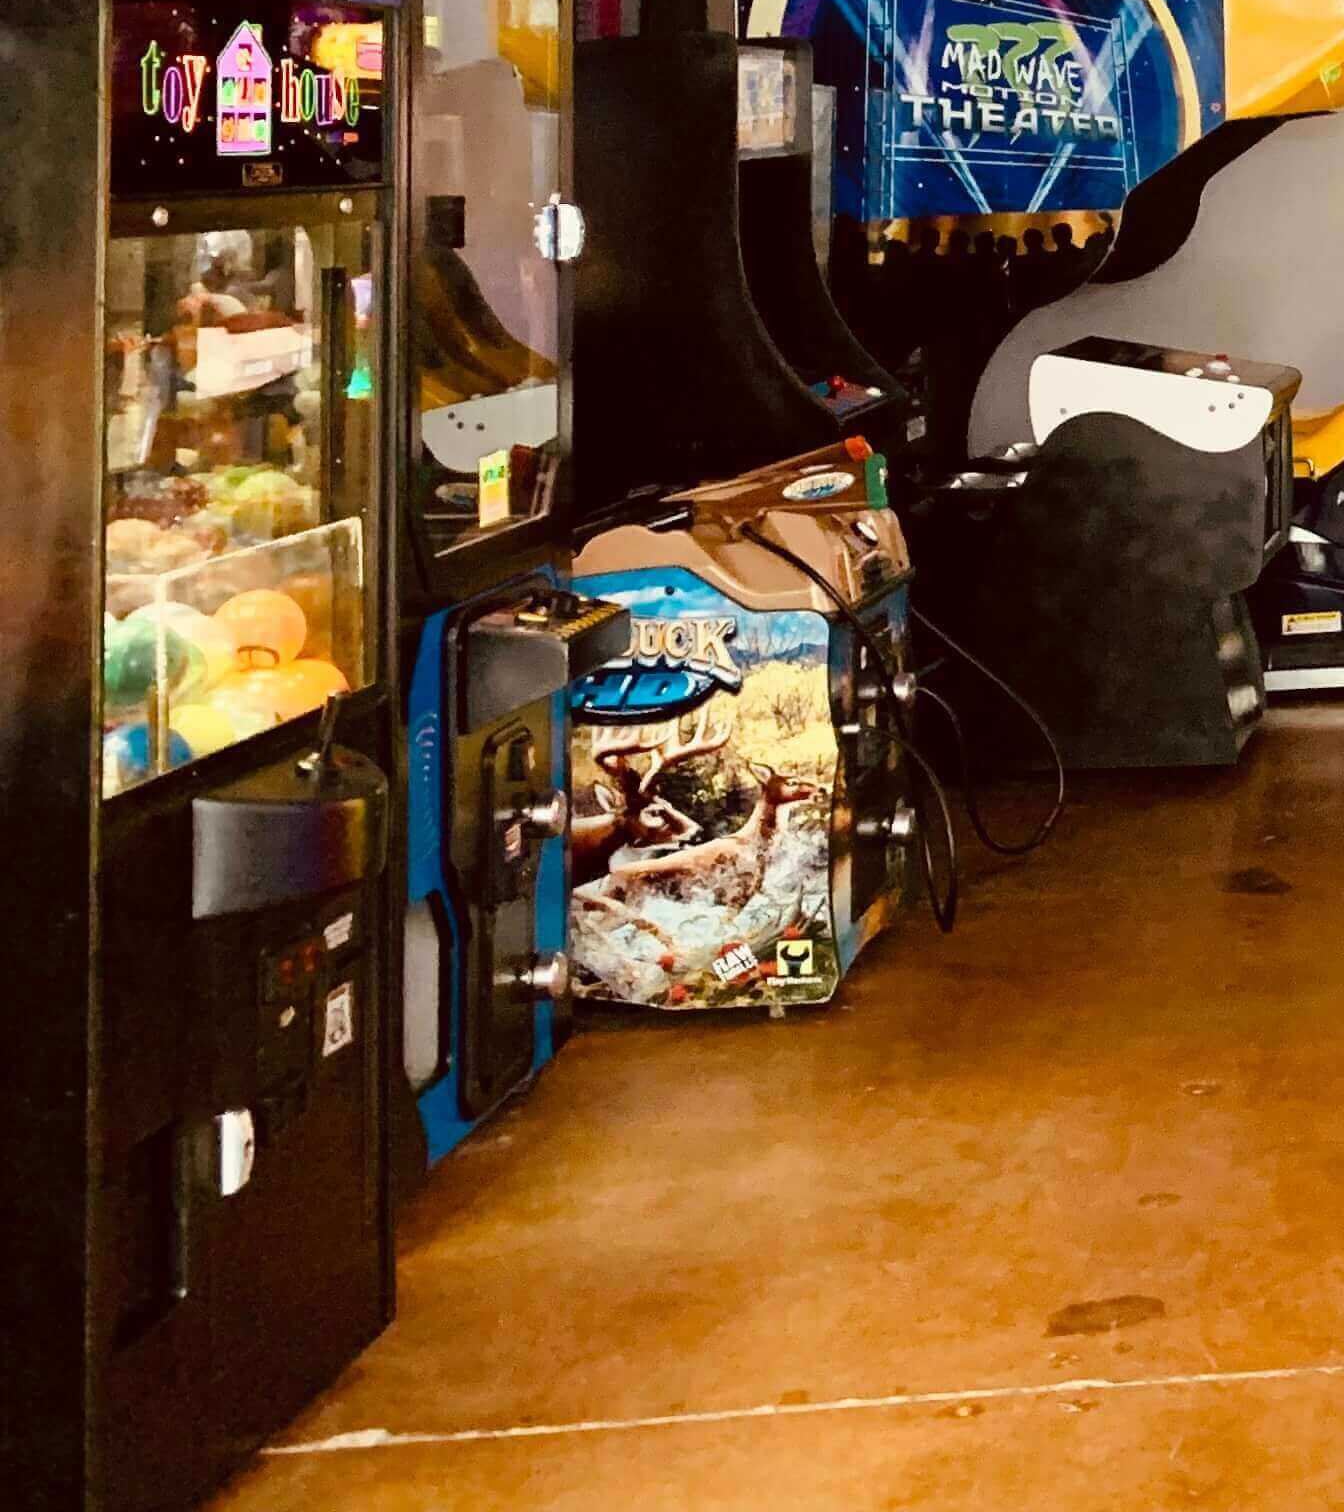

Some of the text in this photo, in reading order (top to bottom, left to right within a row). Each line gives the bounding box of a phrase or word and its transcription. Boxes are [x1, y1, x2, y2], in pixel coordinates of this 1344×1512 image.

[140, 40, 360, 132] toy house
[941, 42, 1084, 93] MAD WAVE
[901, 94, 1120, 137] THEATER
[941, 81, 1084, 108] MOTION
[624, 616, 742, 686] UCK
